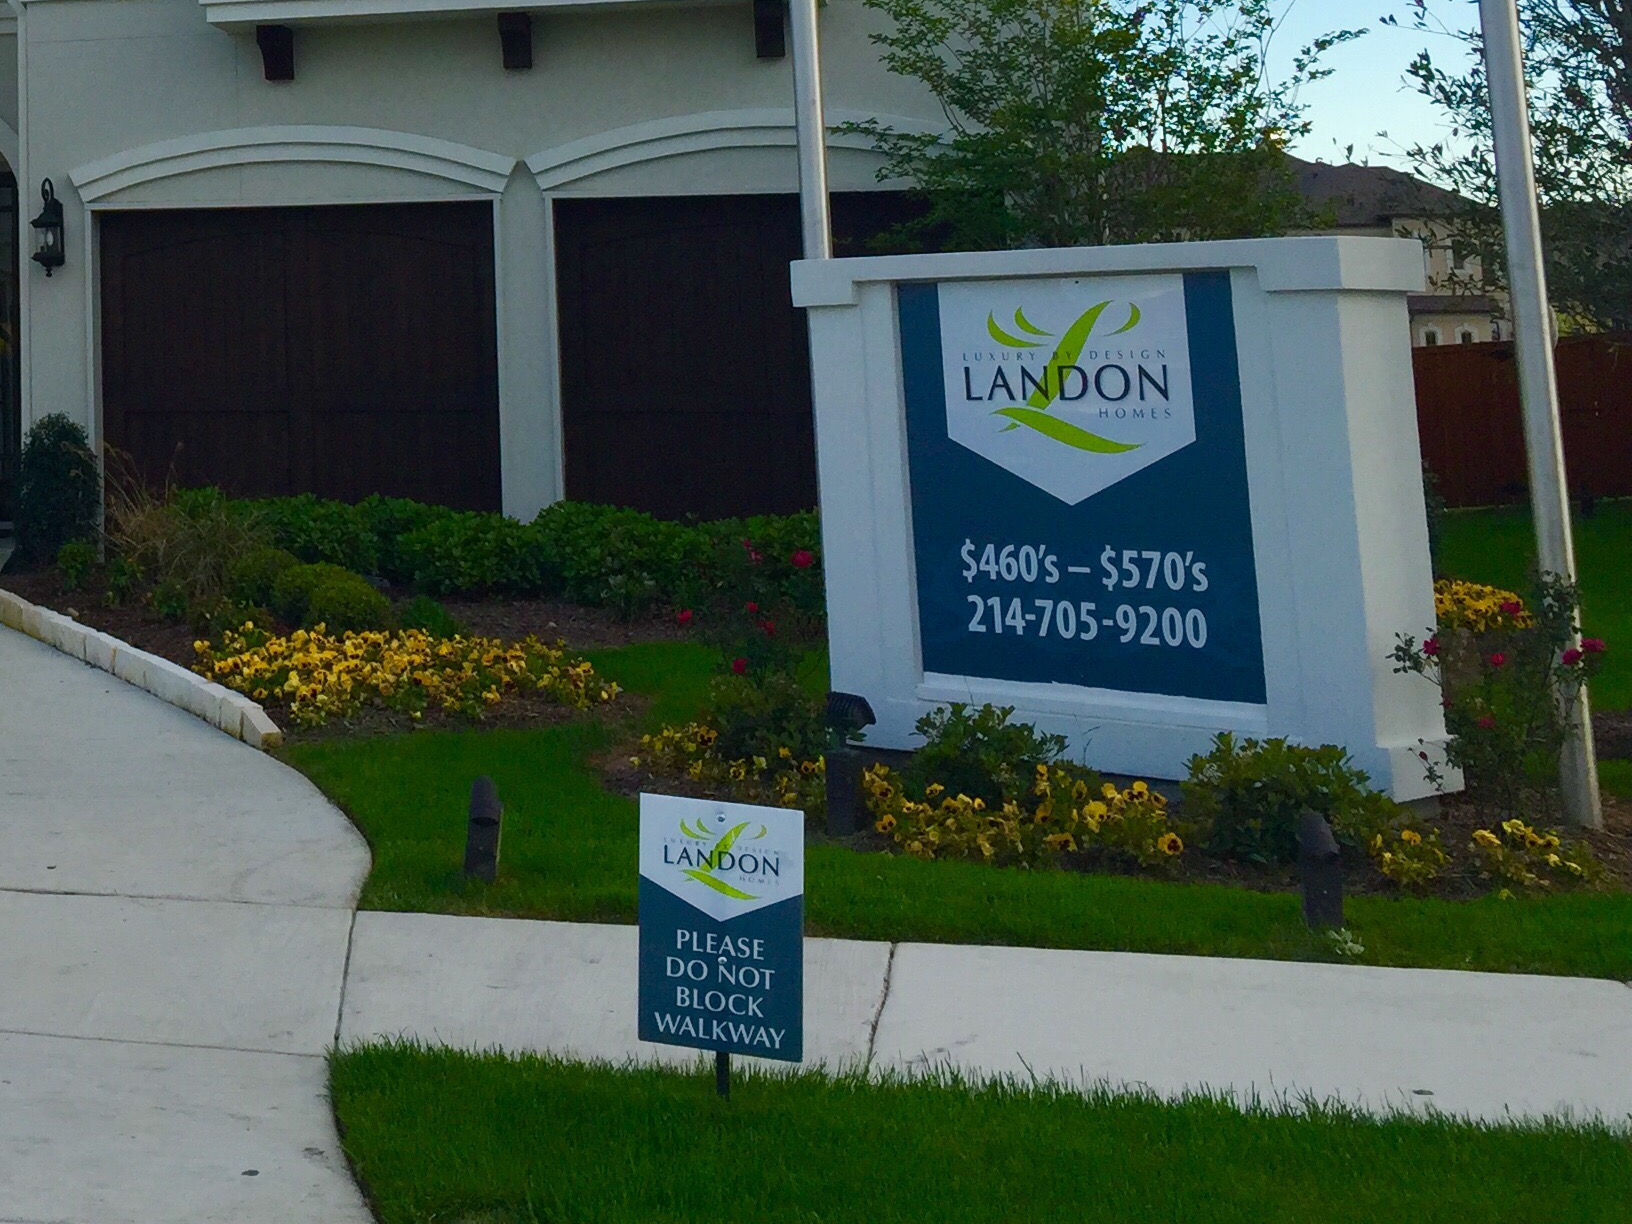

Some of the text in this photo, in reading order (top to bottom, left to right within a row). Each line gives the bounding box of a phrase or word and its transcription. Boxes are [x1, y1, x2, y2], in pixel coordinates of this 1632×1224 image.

[963, 349, 1166, 362] LUXURY BY DESIGN
[963, 364, 1170, 402] LANDON
[1099, 408, 1172, 419] HOMES
[967, 595, 1208, 649] 214-705-9200
[663, 844, 780, 877] LANDON
[676, 929, 765, 961] PLEASE
[666, 956, 775, 991] DO NOT
[676, 985, 764, 1018] BLOCK
[654, 1011, 786, 1050] WALKWAY
